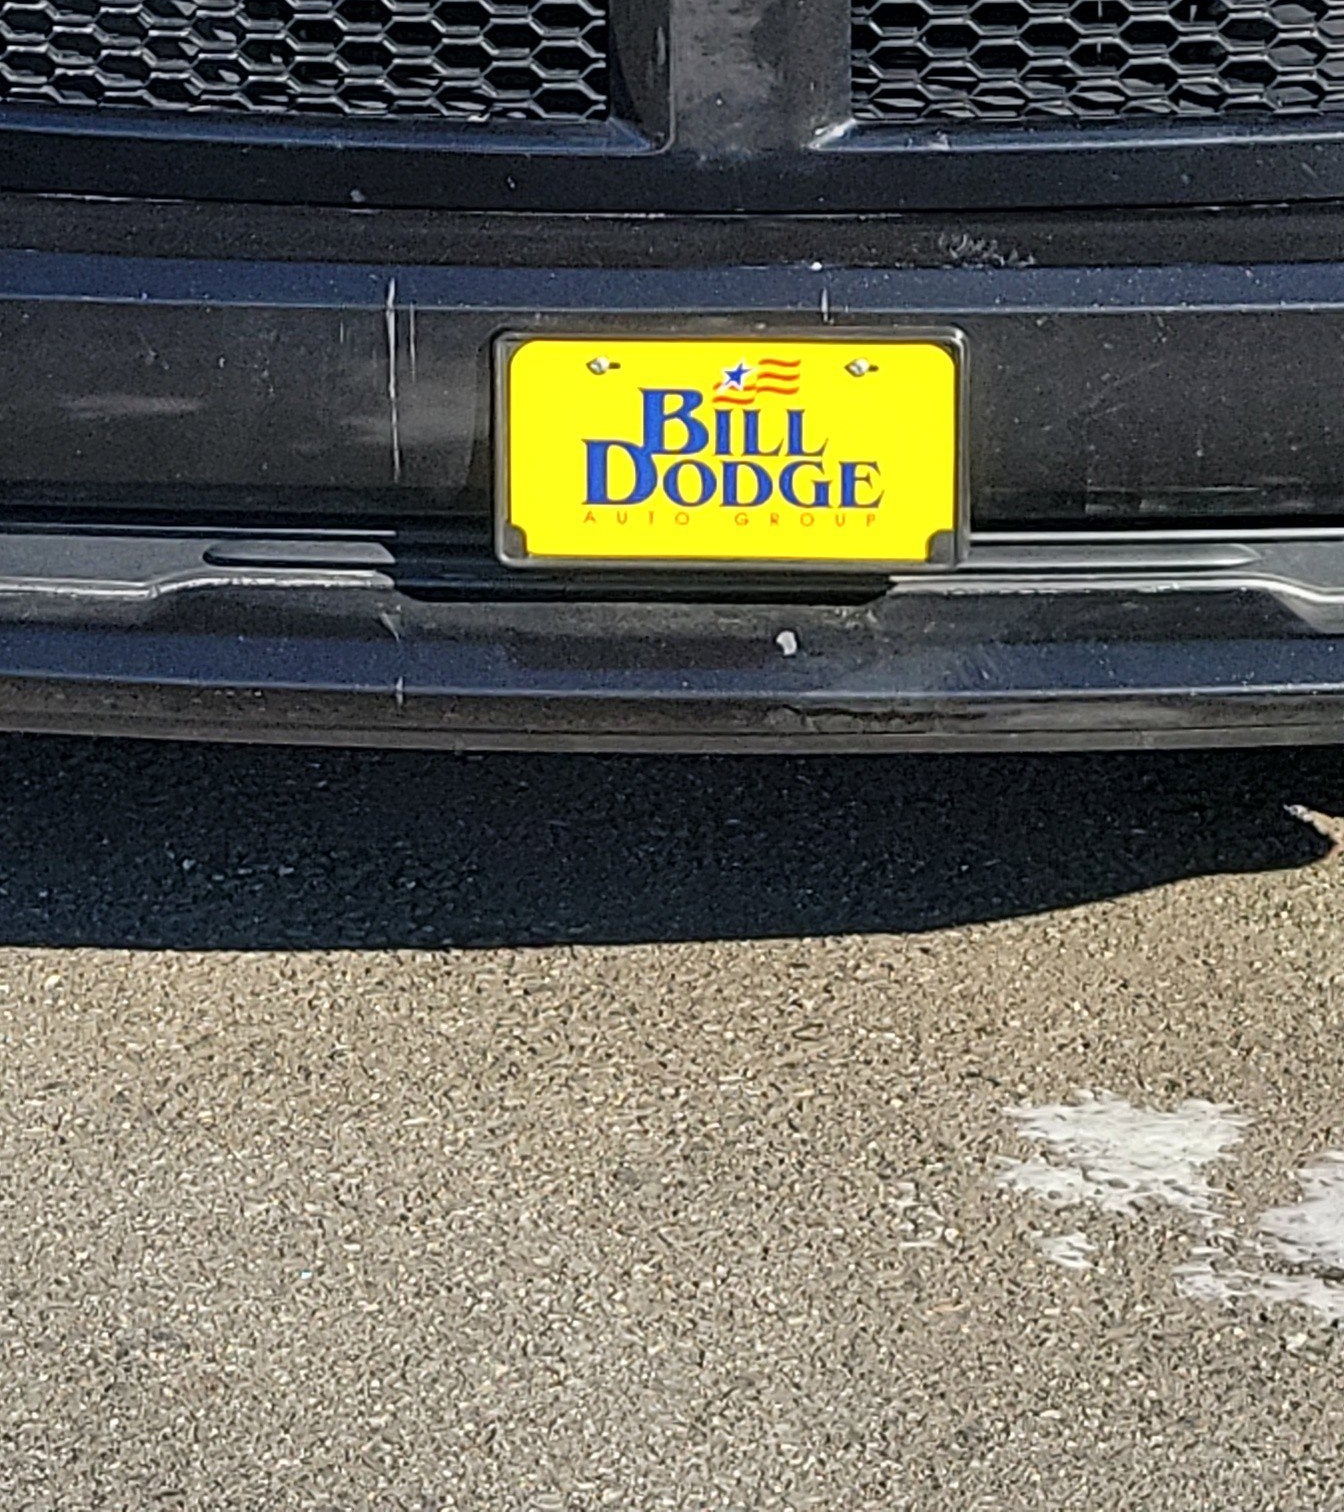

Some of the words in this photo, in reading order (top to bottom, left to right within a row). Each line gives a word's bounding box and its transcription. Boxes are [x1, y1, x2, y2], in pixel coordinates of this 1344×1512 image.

[639, 387, 828, 457] BILL
[582, 439, 885, 509] DODGE
[582, 511, 691, 527] AUTO
[734, 512, 877, 528] GROUP
